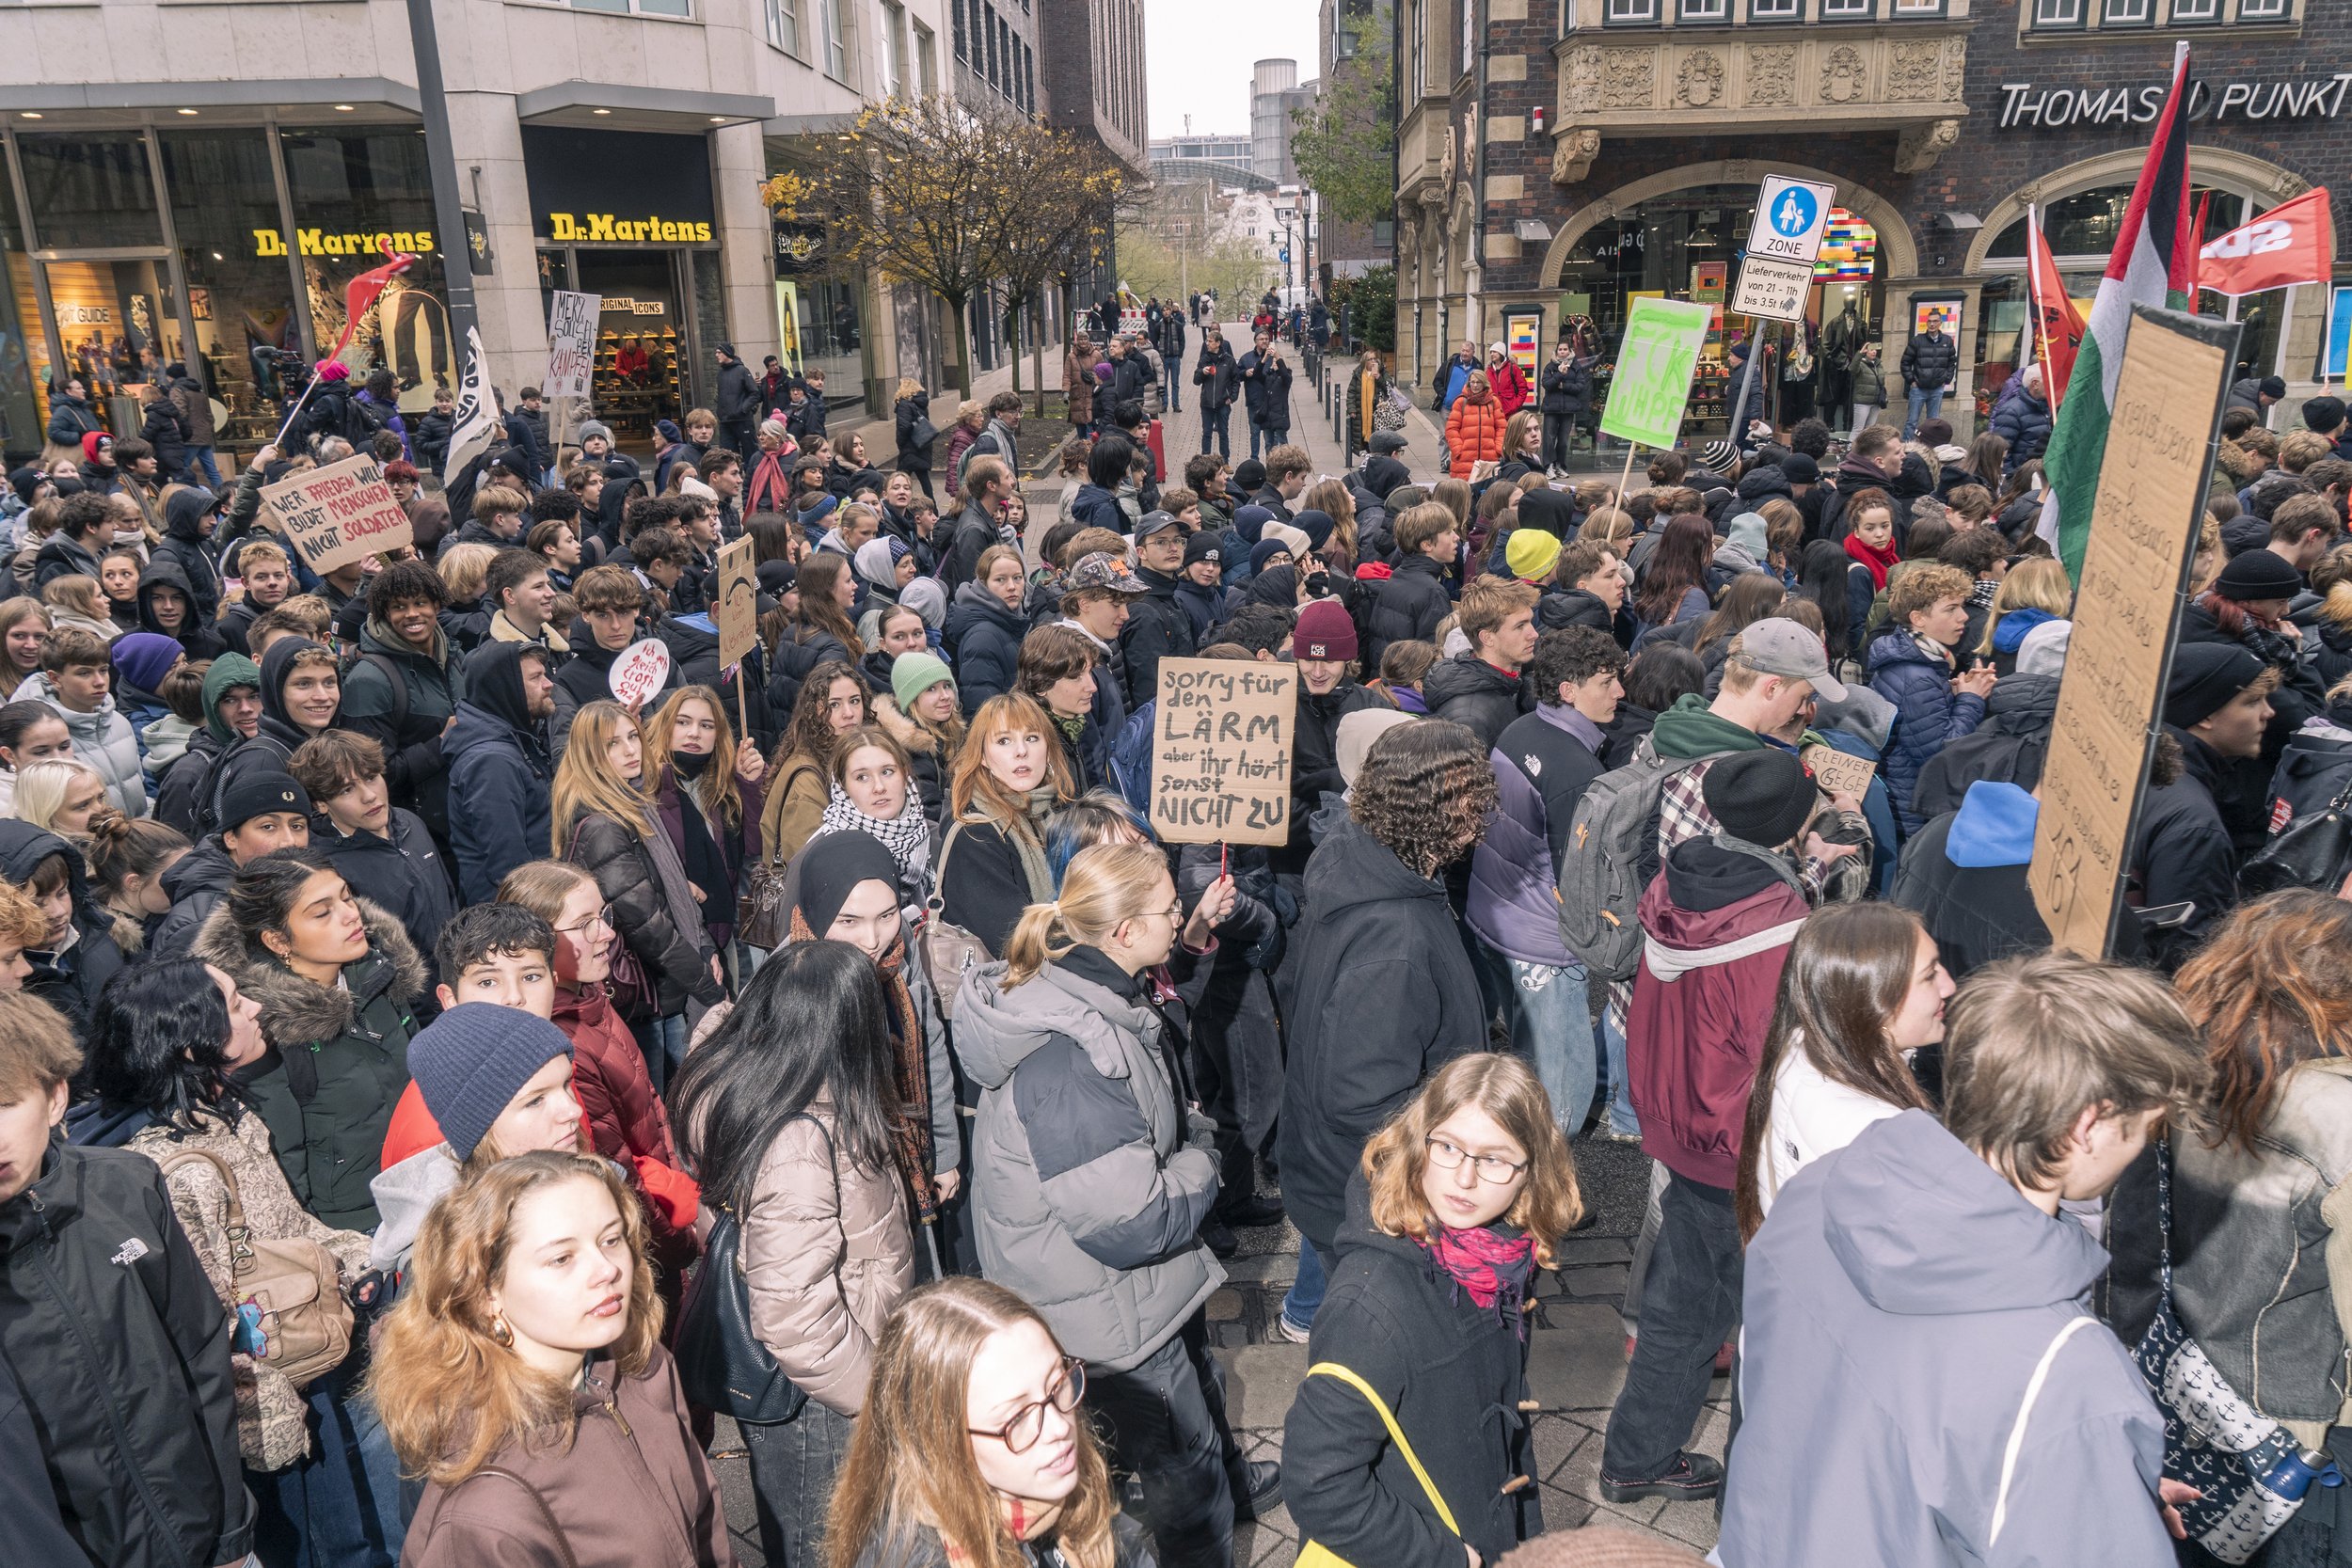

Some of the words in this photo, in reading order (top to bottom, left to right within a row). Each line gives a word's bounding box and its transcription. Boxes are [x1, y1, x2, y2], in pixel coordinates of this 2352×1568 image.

[2000, 83, 2164, 128] THOMAS
[2217, 73, 2352, 119] PUNKT
[1767, 238, 1804, 255] ZONE
[1937, 257, 1945, 265] 21
[1746, 264, 1807, 282] Lieferverkehr
[1748, 281, 1763, 292] von
[1766, 284, 1776, 293] 21
[77, 308, 110, 323] GUIDE
[601, 298, 633, 310] RIGINAL
[634, 302, 660, 314] ICONS
[1744, 295, 1757, 306] bis
[1620, 325, 1693, 394] FCK
[1610, 381, 1687, 431] WHPF
[271, 490, 308, 515] WER
[304, 475, 356, 502] FRIEDEN
[352, 465, 385, 485] WILL
[286, 506, 327, 533] BILDET
[326, 482, 392, 520] MENSCHEN
[301, 526, 342, 562] NICHT
[343, 504, 407, 542] SOLDATEN
[1164, 670, 1234, 703] sorry
[1239, 672, 1290, 696] für
[1167, 687, 1212, 708] den
[1164, 709, 1279, 745] LÄRM
[1162, 746, 1197, 763] aber
[1200, 746, 1233, 777] ihr
[1236, 748, 1290, 782] hört
[1812, 749, 1870, 774] KLEINER
[1156, 793, 1245, 829] NICHT
[1246, 796, 1284, 830] ZU
